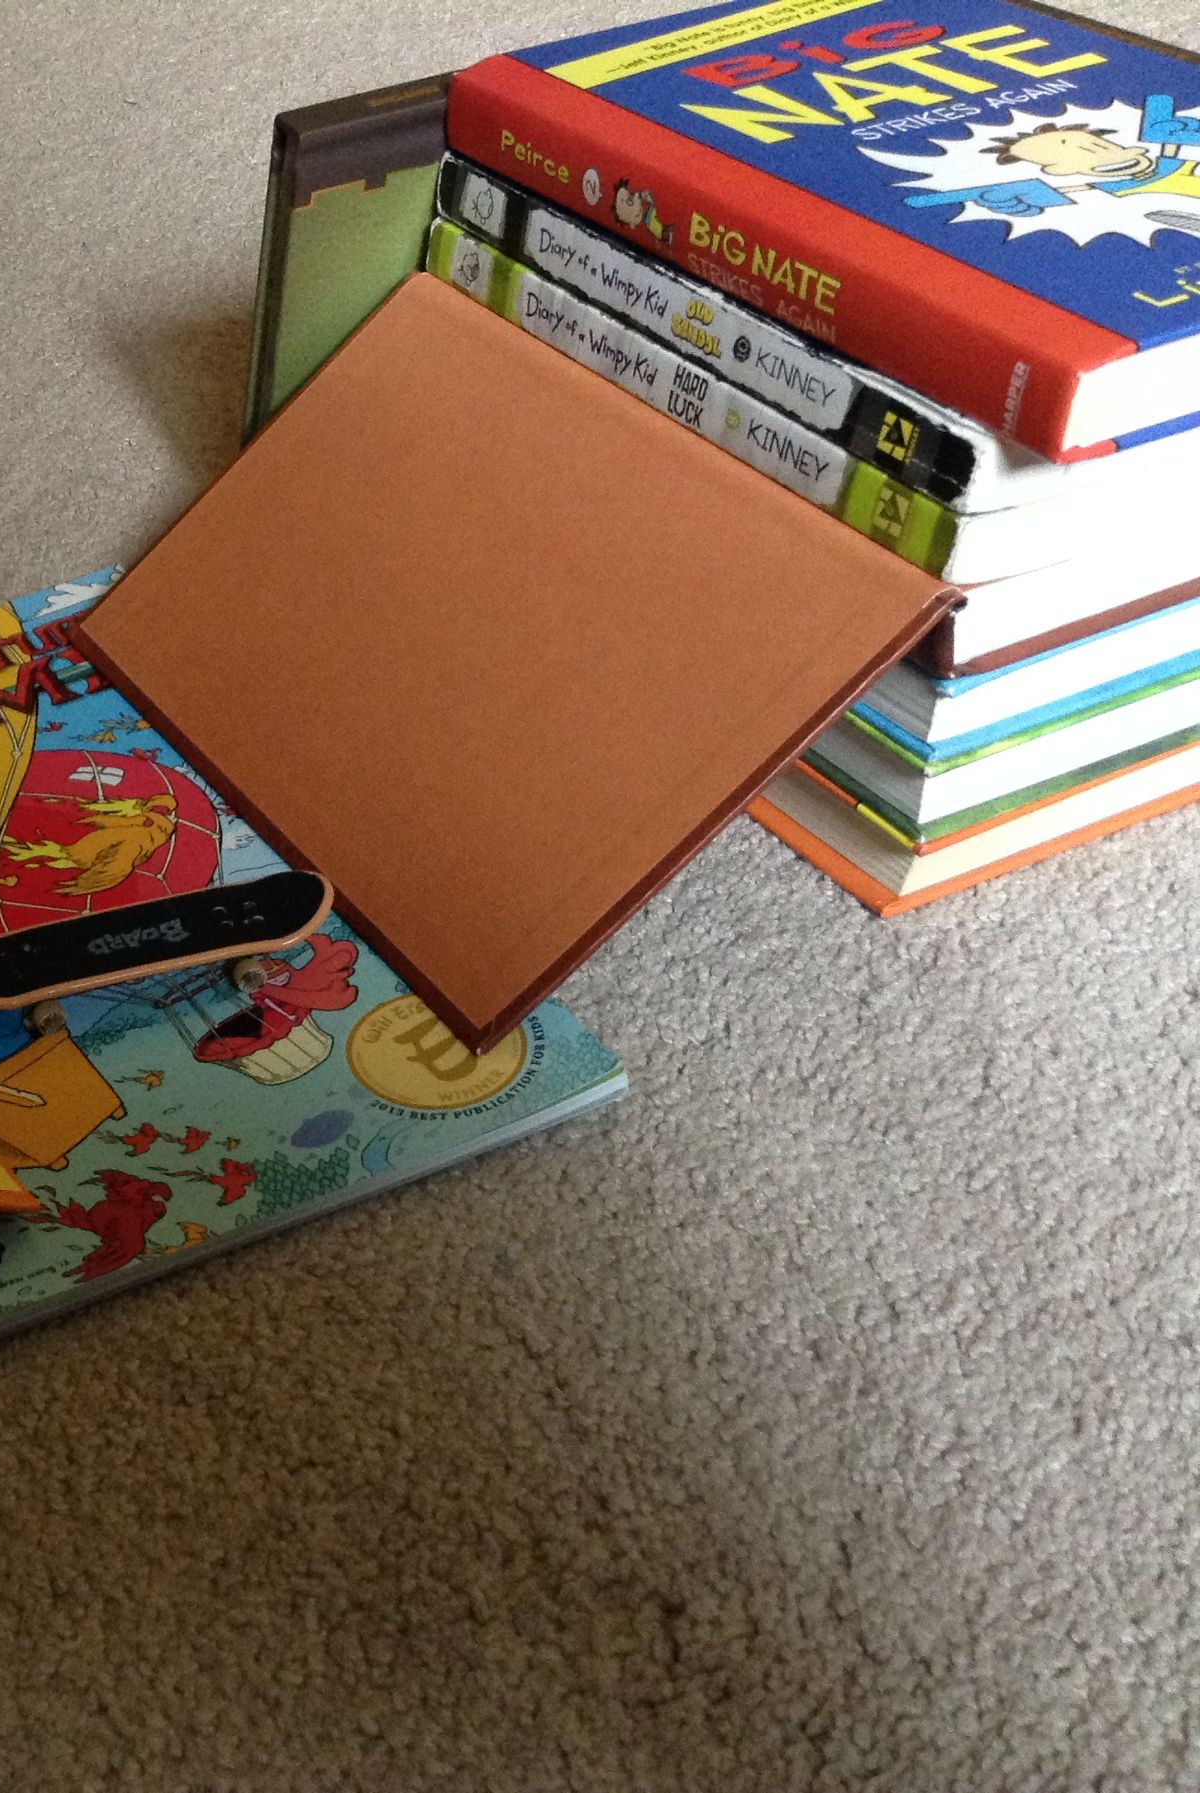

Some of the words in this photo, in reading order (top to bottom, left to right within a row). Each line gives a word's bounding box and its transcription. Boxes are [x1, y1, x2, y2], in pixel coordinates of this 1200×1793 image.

[680, 24, 1109, 144] NATE
[851, 102, 981, 142] STRIKES
[979, 78, 1080, 113] AGAIN
[501, 129, 571, 184] Peirce
[538, 227, 577, 266] Diary
[578, 254, 590, 270] of
[601, 263, 644, 306] Wimpy
[644, 286, 669, 317] Kid
[750, 244, 842, 316] NATE
[526, 291, 564, 333] Diary
[565, 319, 579, 336] of
[589, 328, 632, 375] Wimpy
[632, 353, 659, 387] Kid
[672, 363, 709, 400] HARD
[755, 347, 836, 408] KINNEY
[667, 389, 705, 428] LUCK
[746, 418, 830, 482] KINNEY
[530, 1015, 546, 1043] KIDS
[530, 1043, 546, 1068] FOR
[370, 1099, 404, 1118] 2013
[409, 1110, 447, 1121] BEST
[453, 1066, 538, 1120] PUBLICATION
